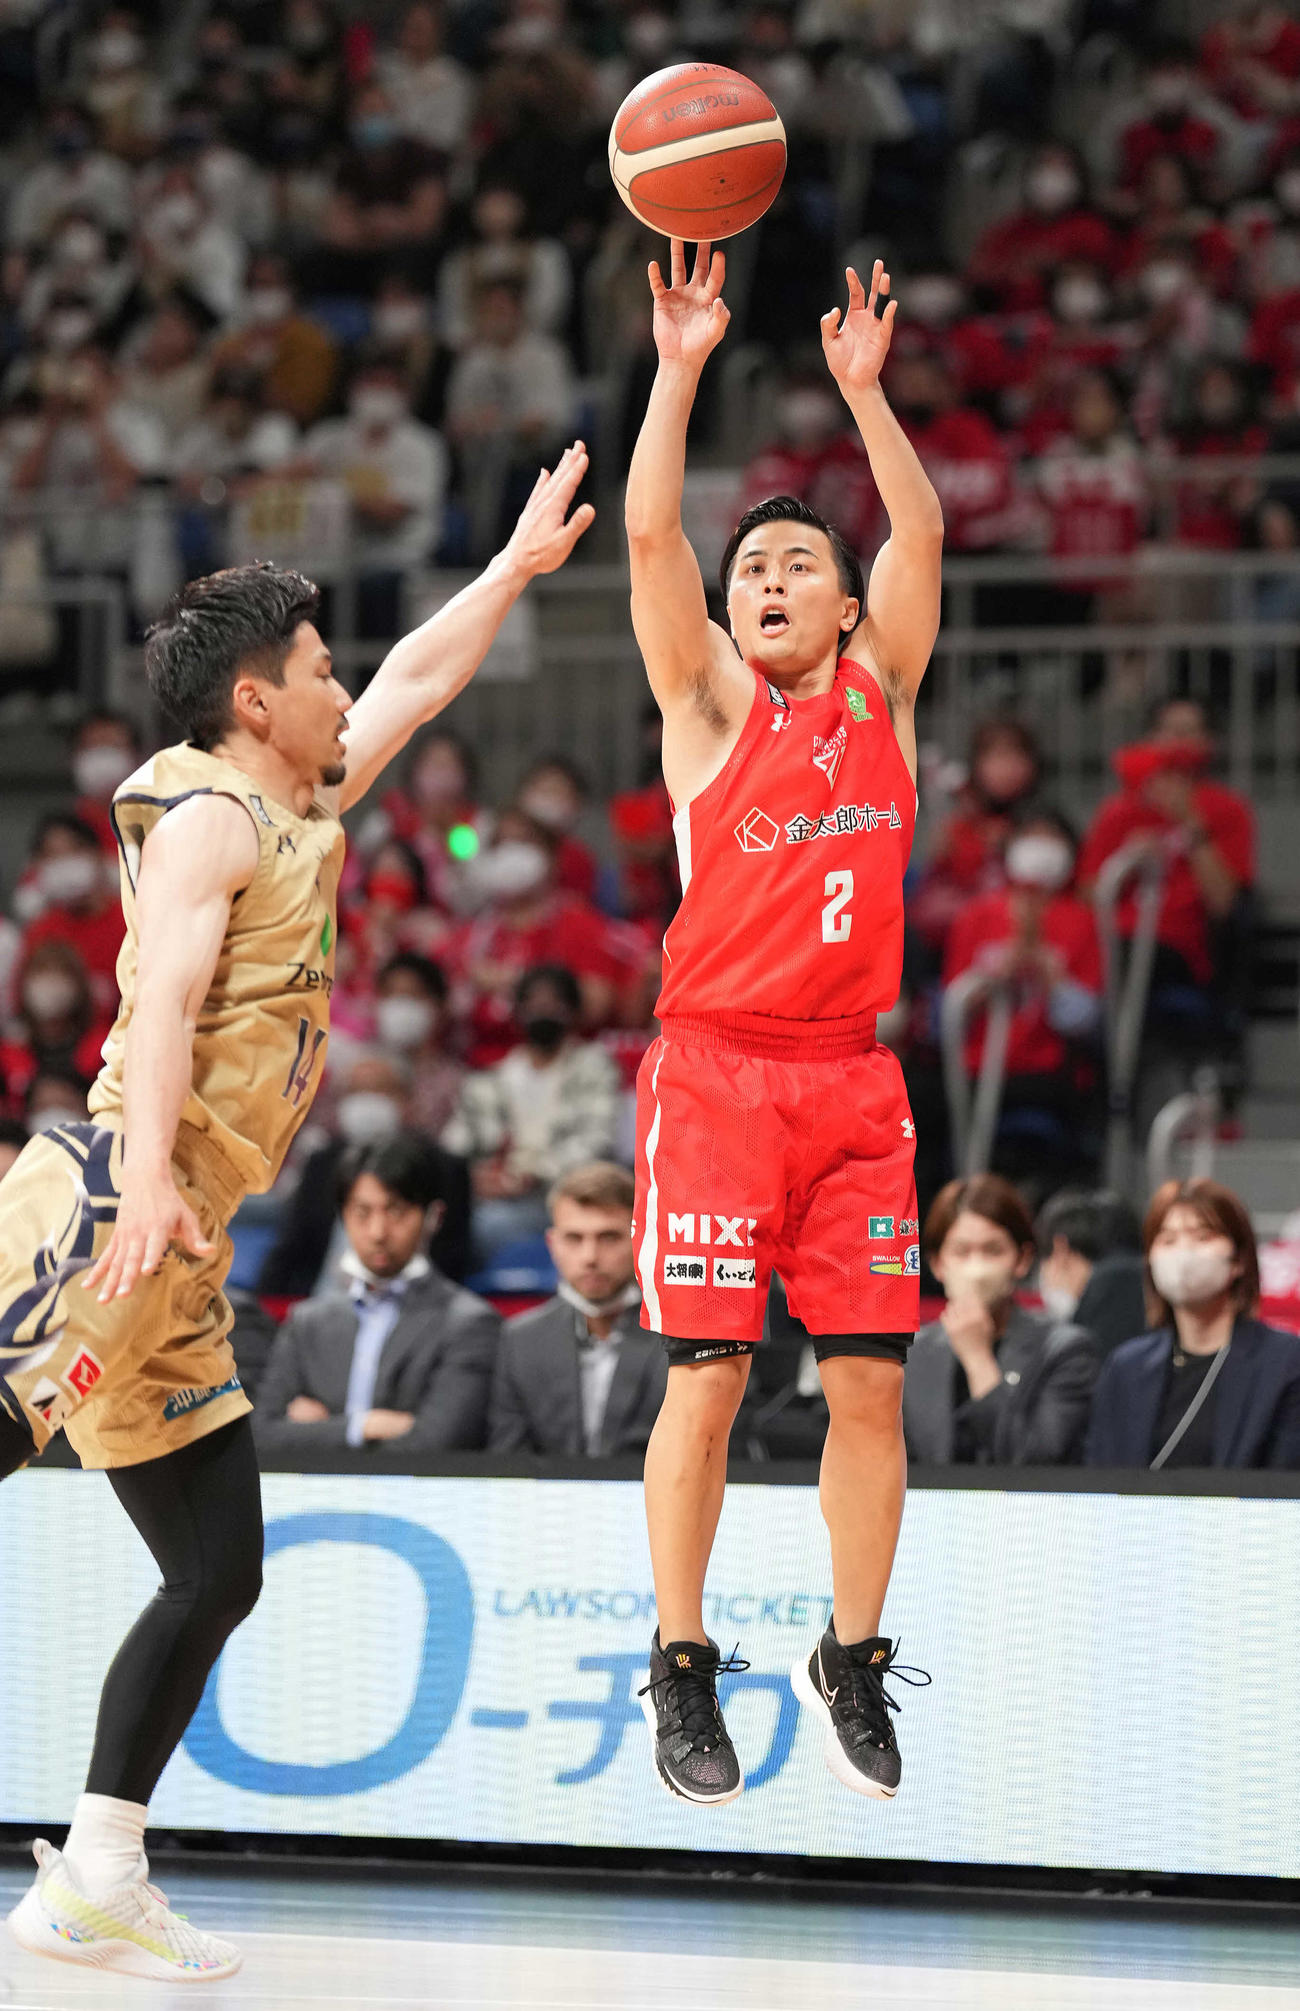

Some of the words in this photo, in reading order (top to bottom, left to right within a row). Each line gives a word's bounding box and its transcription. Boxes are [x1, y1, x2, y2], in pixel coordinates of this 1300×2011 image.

[662, 93, 740, 123] molten
[786, 802, 902, 844] 金太郎ホーム
[822, 869, 854, 944] 2
[282, 1017, 327, 1107] 14
[703, 1592, 834, 1626] ICKET
